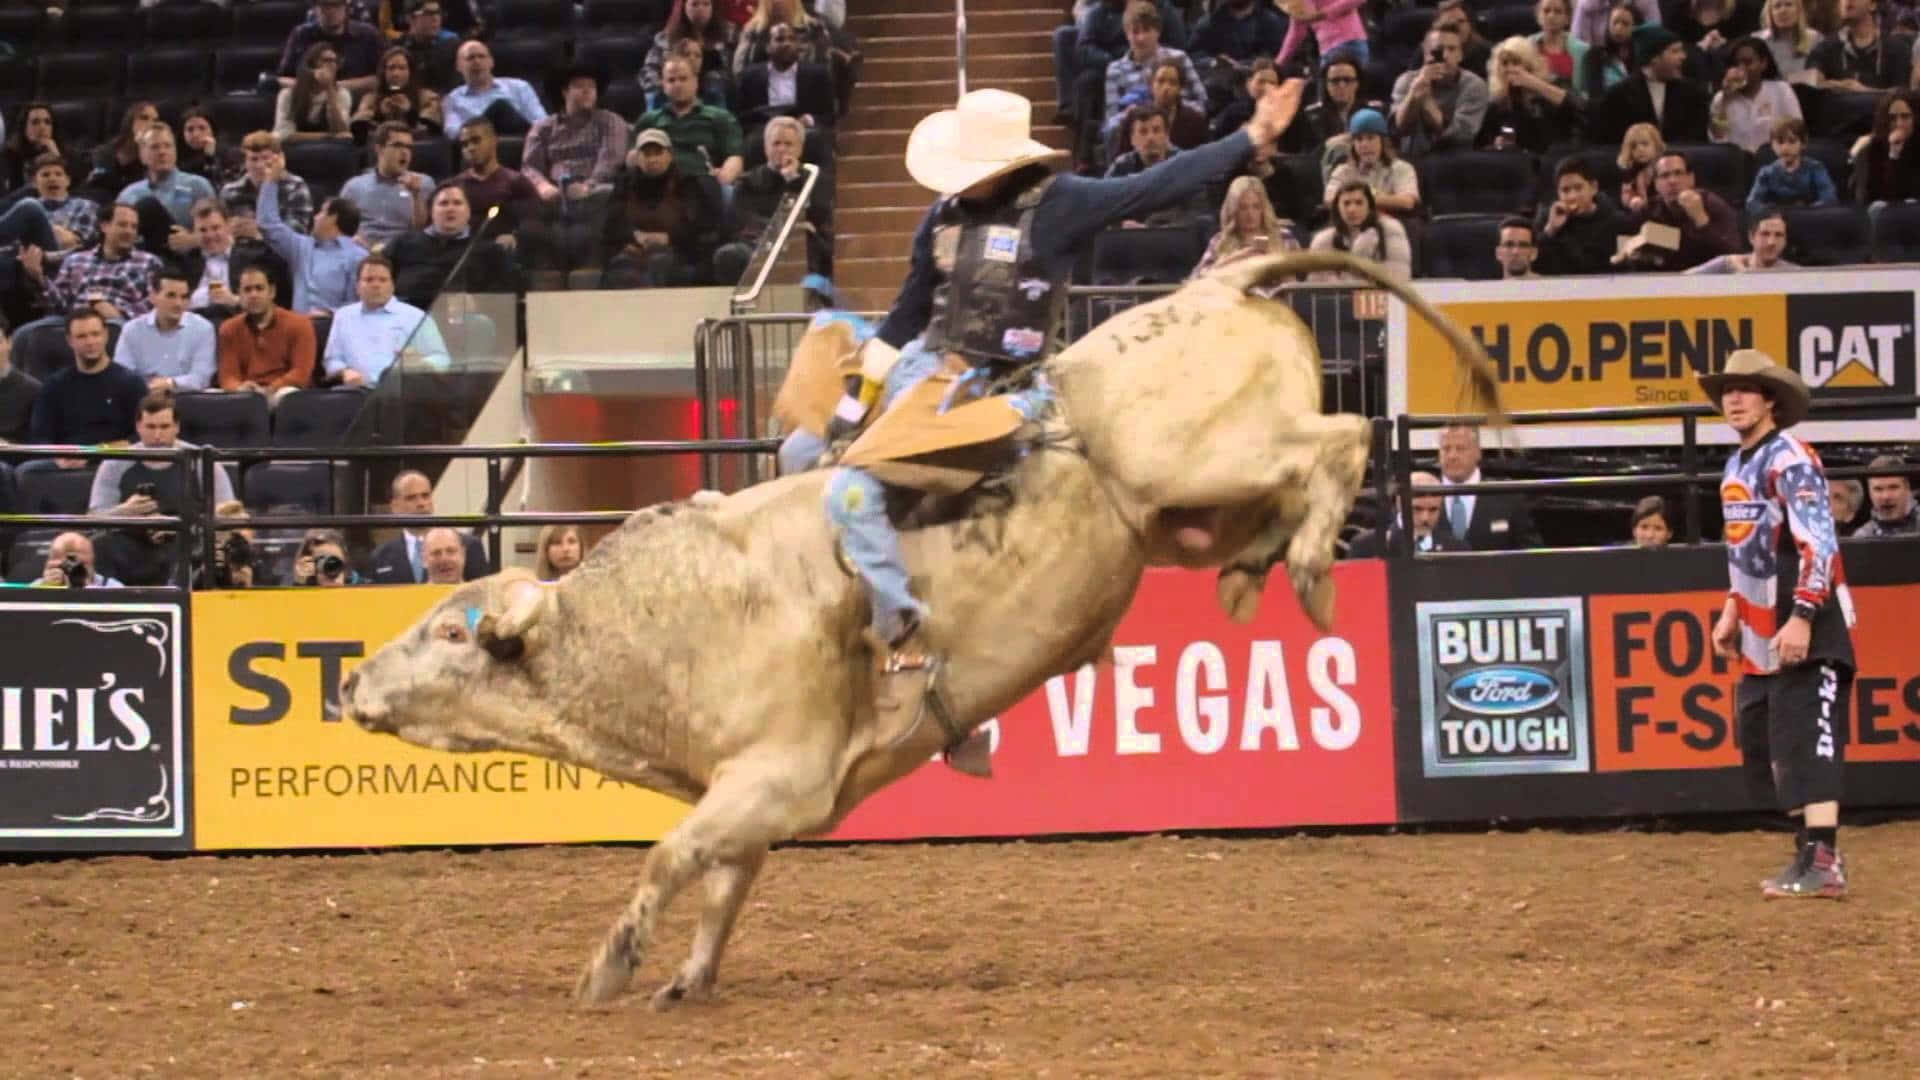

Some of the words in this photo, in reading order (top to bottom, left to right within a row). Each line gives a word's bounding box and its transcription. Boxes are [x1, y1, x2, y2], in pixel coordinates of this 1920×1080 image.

[1800, 325, 1902, 388] CAT
[1635, 385, 1690, 402] Since
[1437, 617, 1564, 664] BUILT
[1045, 637, 1361, 757] VEGAS
[1470, 675, 1533, 702] Ford
[1441, 717, 1568, 755] TOUGH
[231, 760, 528, 798] PERFORMANCE
[544, 760, 580, 791] IN
